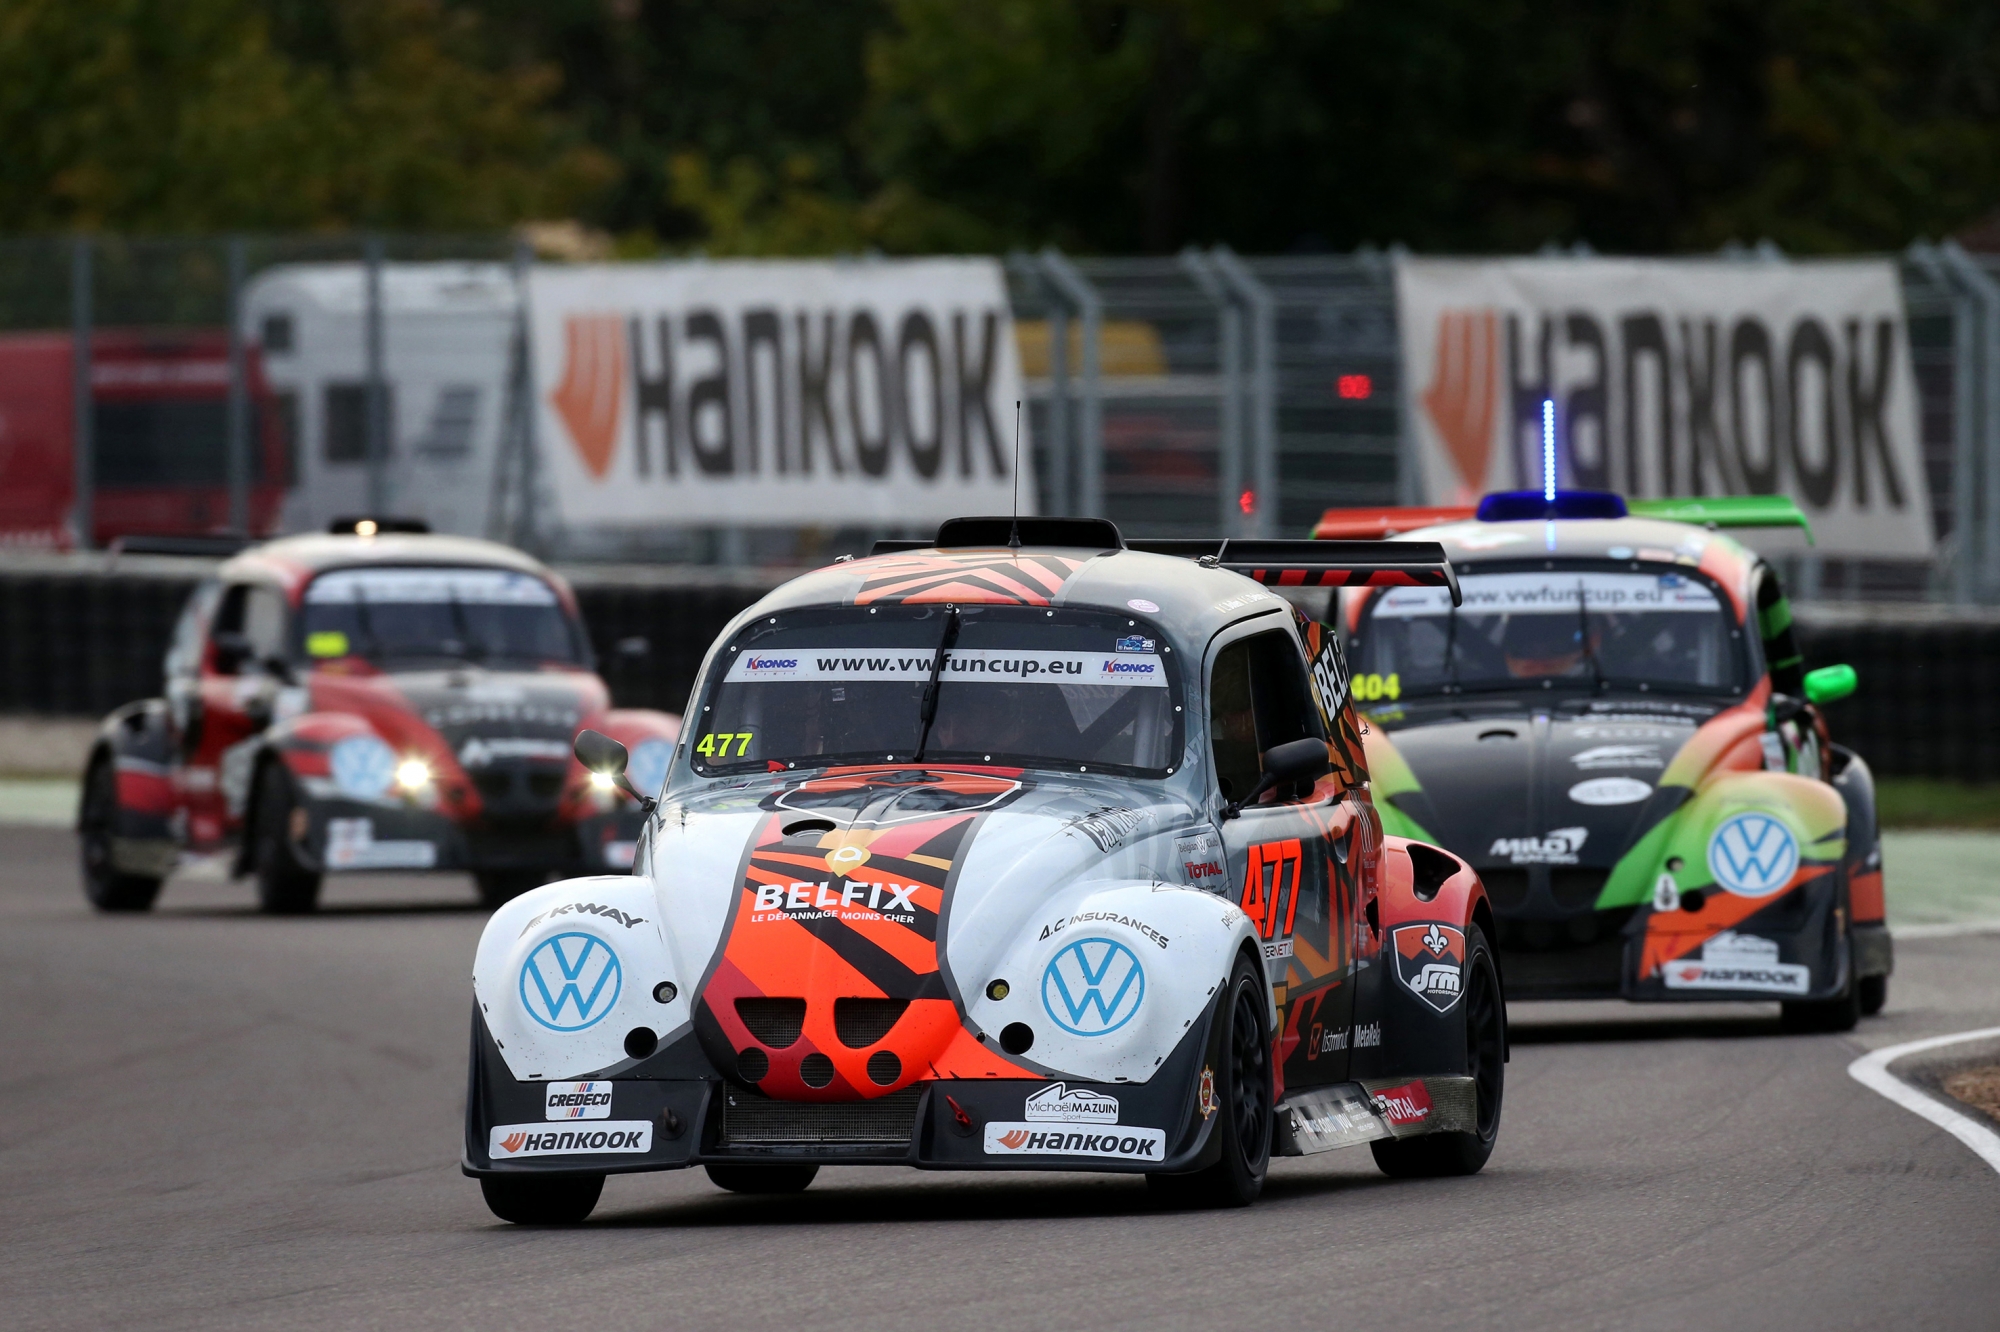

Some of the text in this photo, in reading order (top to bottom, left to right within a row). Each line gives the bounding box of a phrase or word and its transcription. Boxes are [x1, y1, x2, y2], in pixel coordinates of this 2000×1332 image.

[746, 655, 798, 670] KRONOS
[816, 653, 1083, 676] www.vwfuncup.eu
[1102, 657, 1155, 673] KRONOS
[1351, 672, 1401, 701] 404
[696, 733, 753, 757] 477
[1185, 861, 1223, 879] TOTAL
[753, 880, 921, 912] BELFIX
[1239, 837, 1303, 942] 477
[751, 909, 915, 924] LE DÉPANNAGE MOINS CHER
[1068, 911, 1170, 950] INSURANCES
[1426, 988, 1460, 997] MOTORSPORT
[547, 1091, 611, 1108] CREDECO
[1061, 1112, 1081, 1121] Sport
